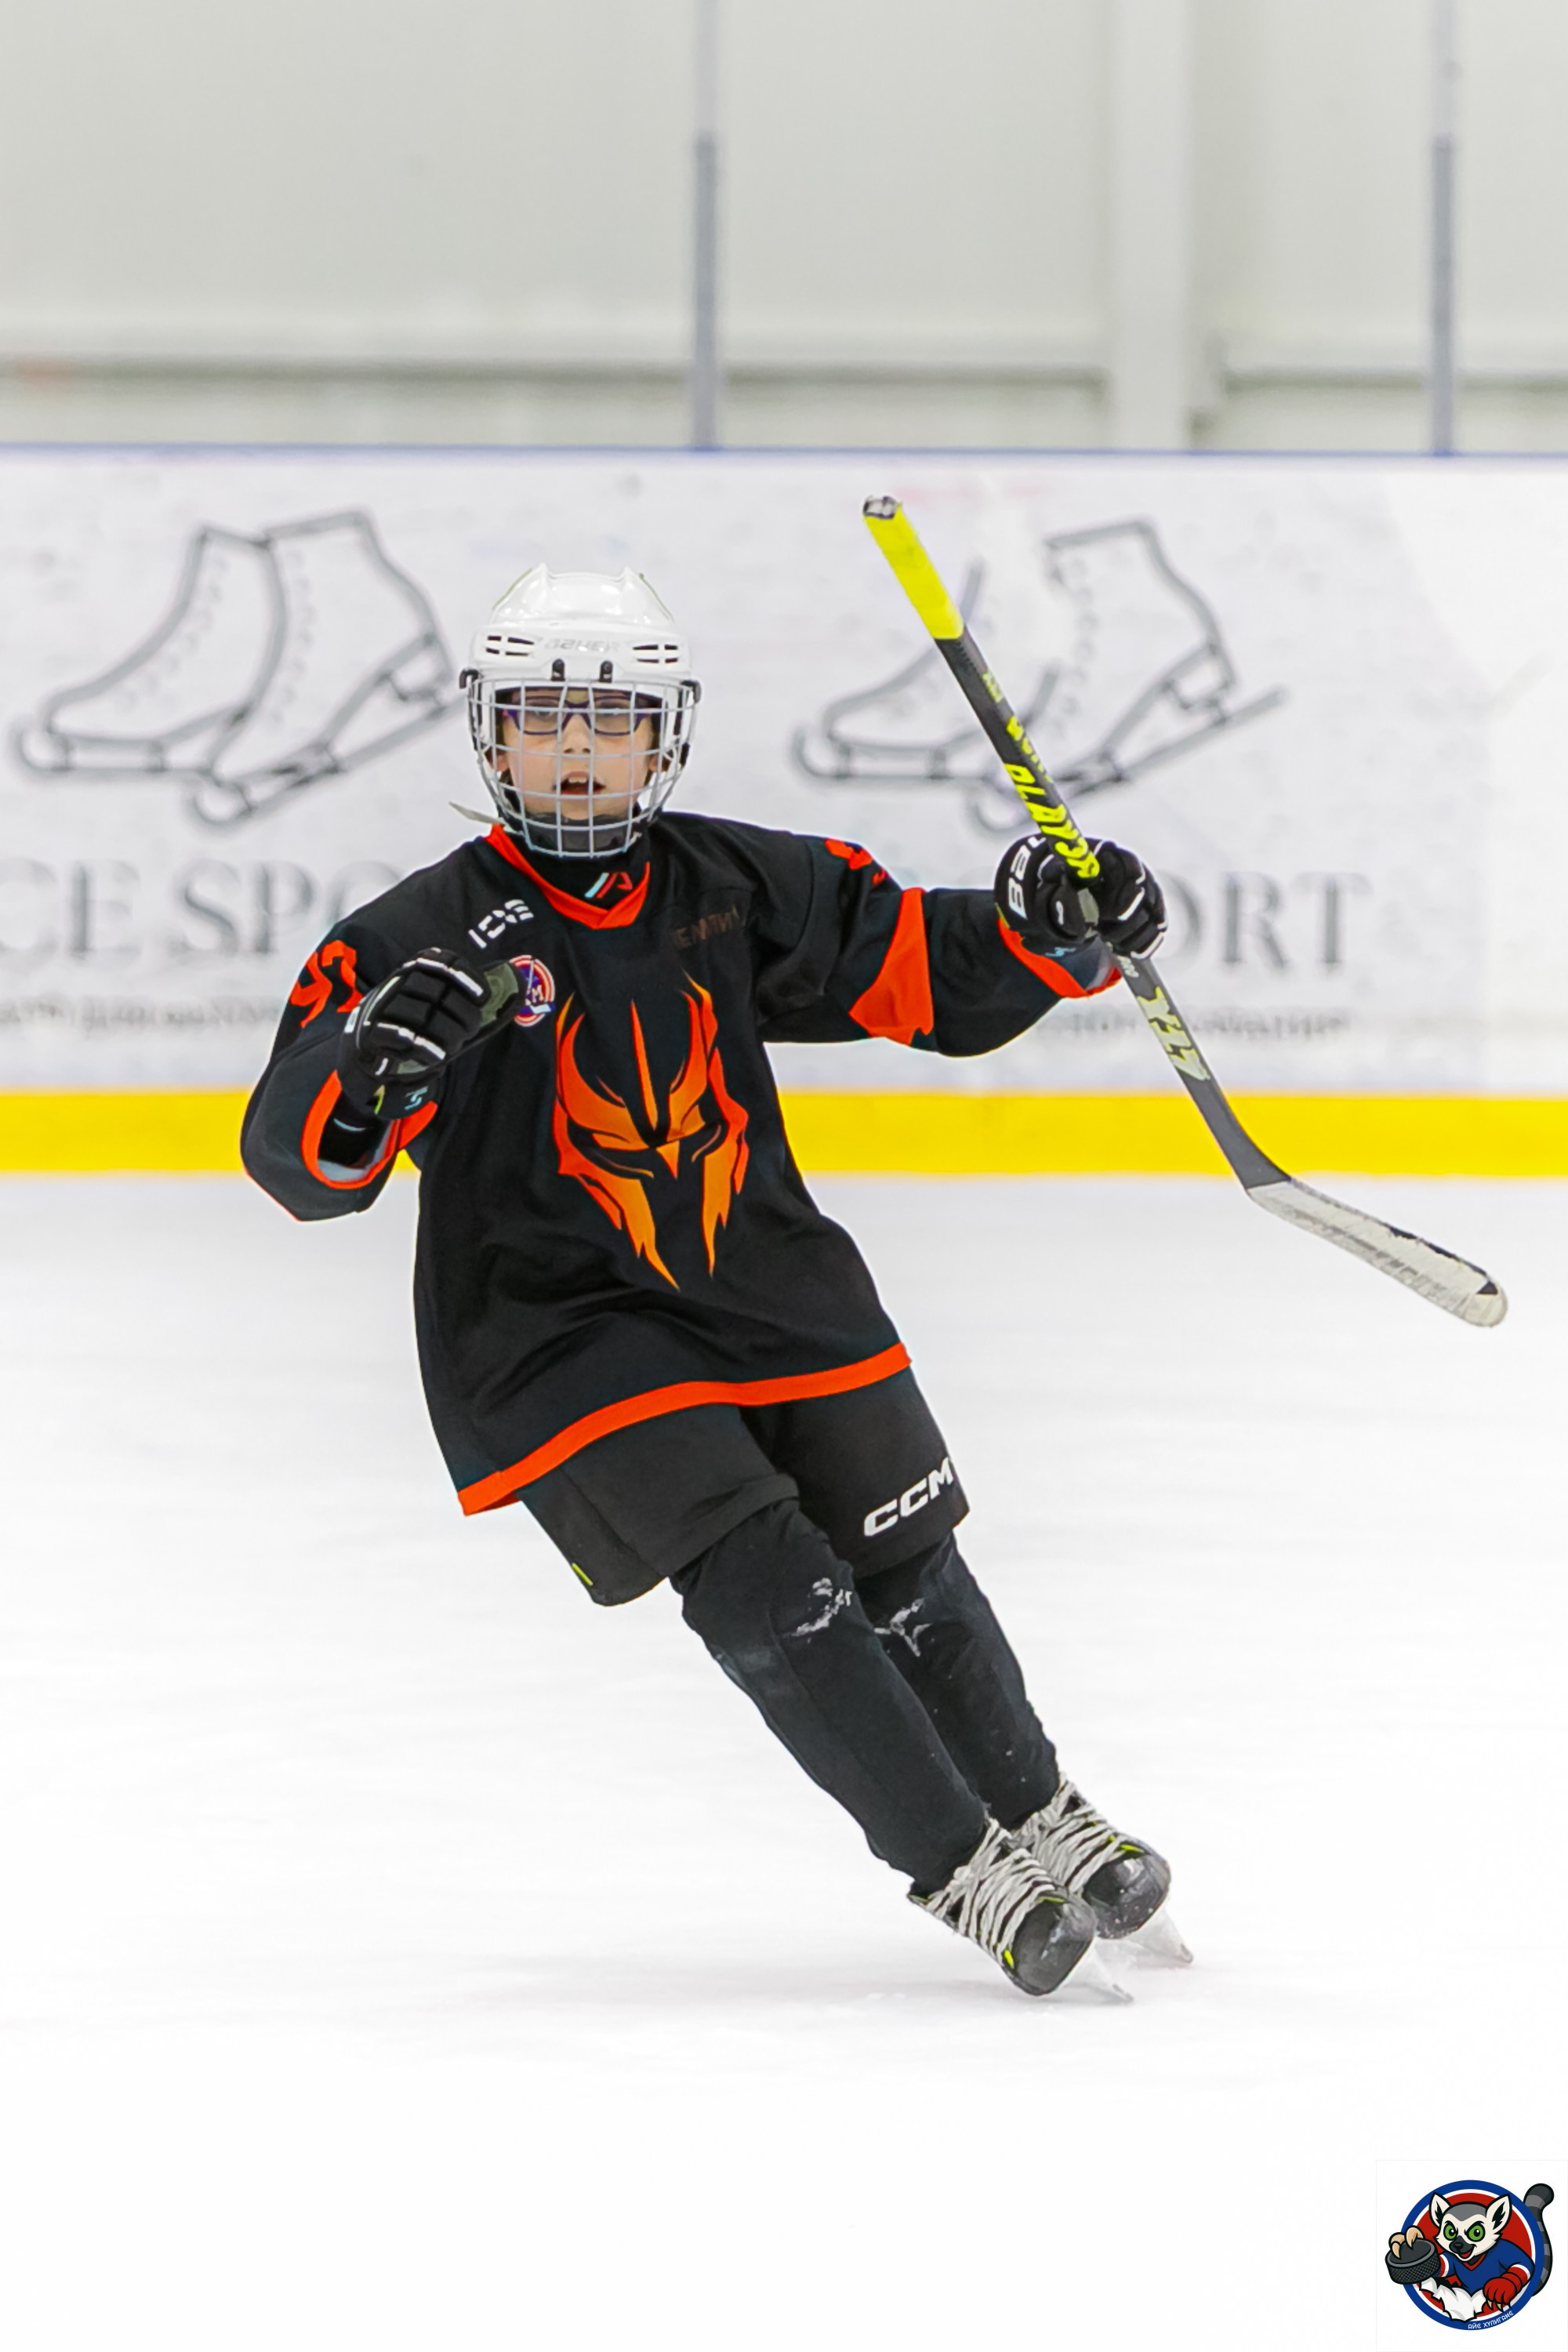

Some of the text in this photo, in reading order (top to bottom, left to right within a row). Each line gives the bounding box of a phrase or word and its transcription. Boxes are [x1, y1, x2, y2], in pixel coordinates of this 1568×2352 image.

[169, 858, 400, 960] SPO
[1156, 869, 1373, 974] ORT
[864, 1456, 953, 1537] CCM
